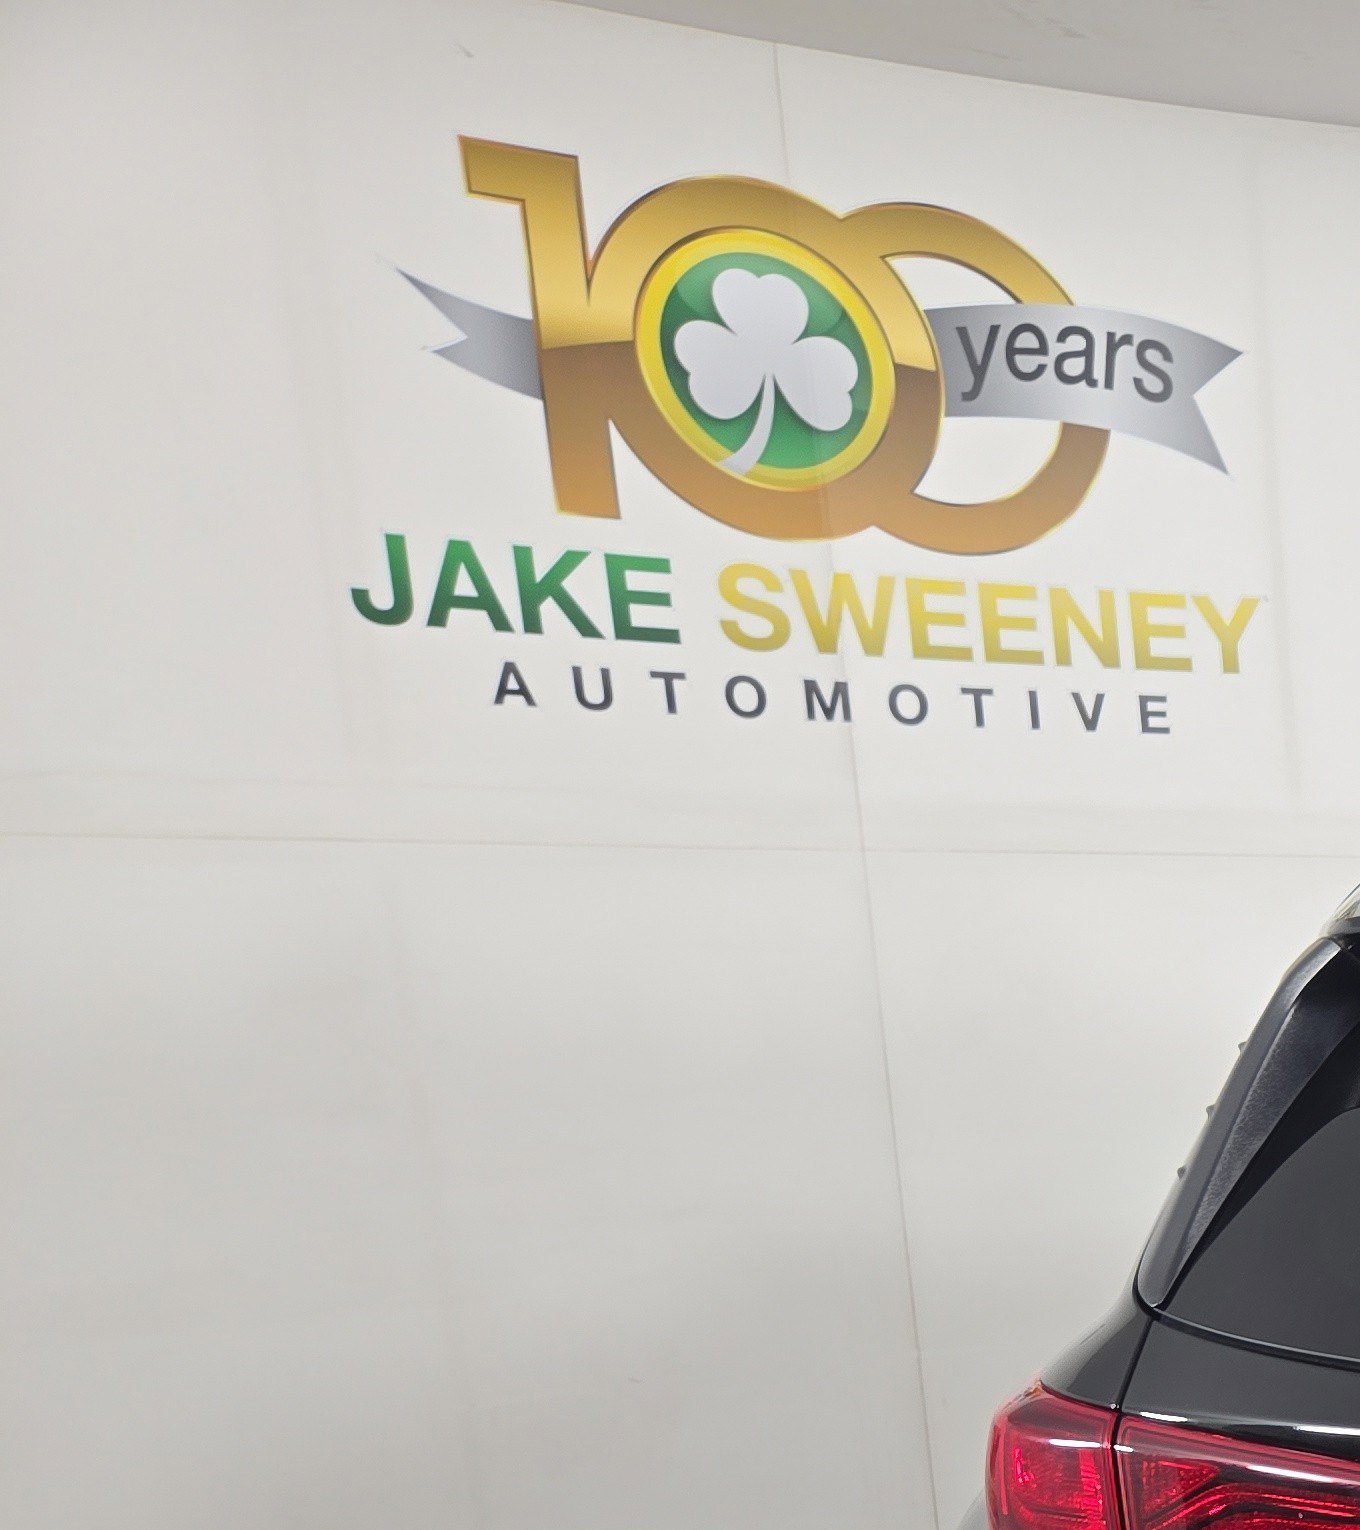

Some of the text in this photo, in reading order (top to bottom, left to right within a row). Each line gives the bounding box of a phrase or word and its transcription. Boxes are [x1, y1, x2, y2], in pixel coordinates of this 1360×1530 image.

[459, 135, 1110, 555] 100
[955, 323, 1173, 402] years
[351, 533, 1260, 675] JAKE SWEENEY
[494, 662, 1170, 734] AUTOMOTIVE
